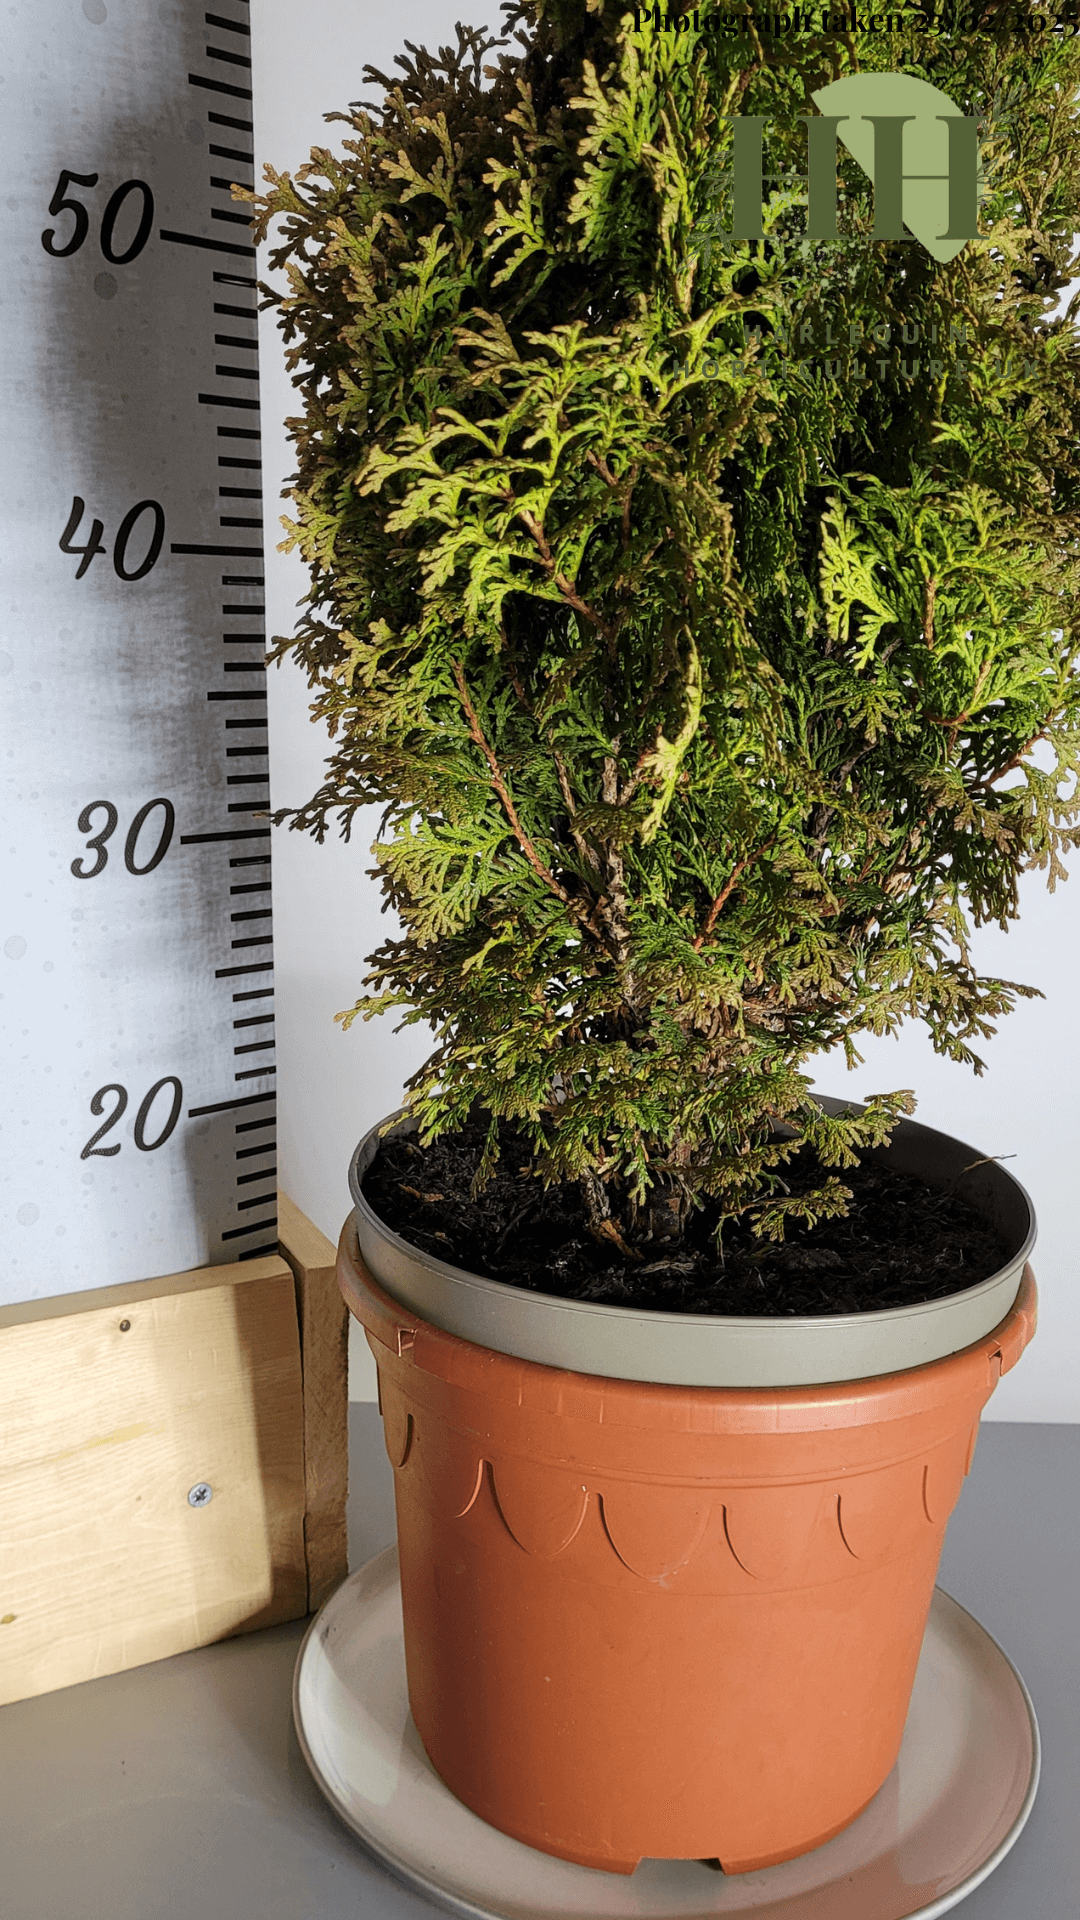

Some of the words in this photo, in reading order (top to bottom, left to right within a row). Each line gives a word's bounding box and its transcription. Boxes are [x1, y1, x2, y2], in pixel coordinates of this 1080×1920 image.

[41, 169, 155, 265] 50
[58, 496, 166, 582] 40
[70, 798, 176, 879] 30
[80, 1075, 184, 1160] 20
